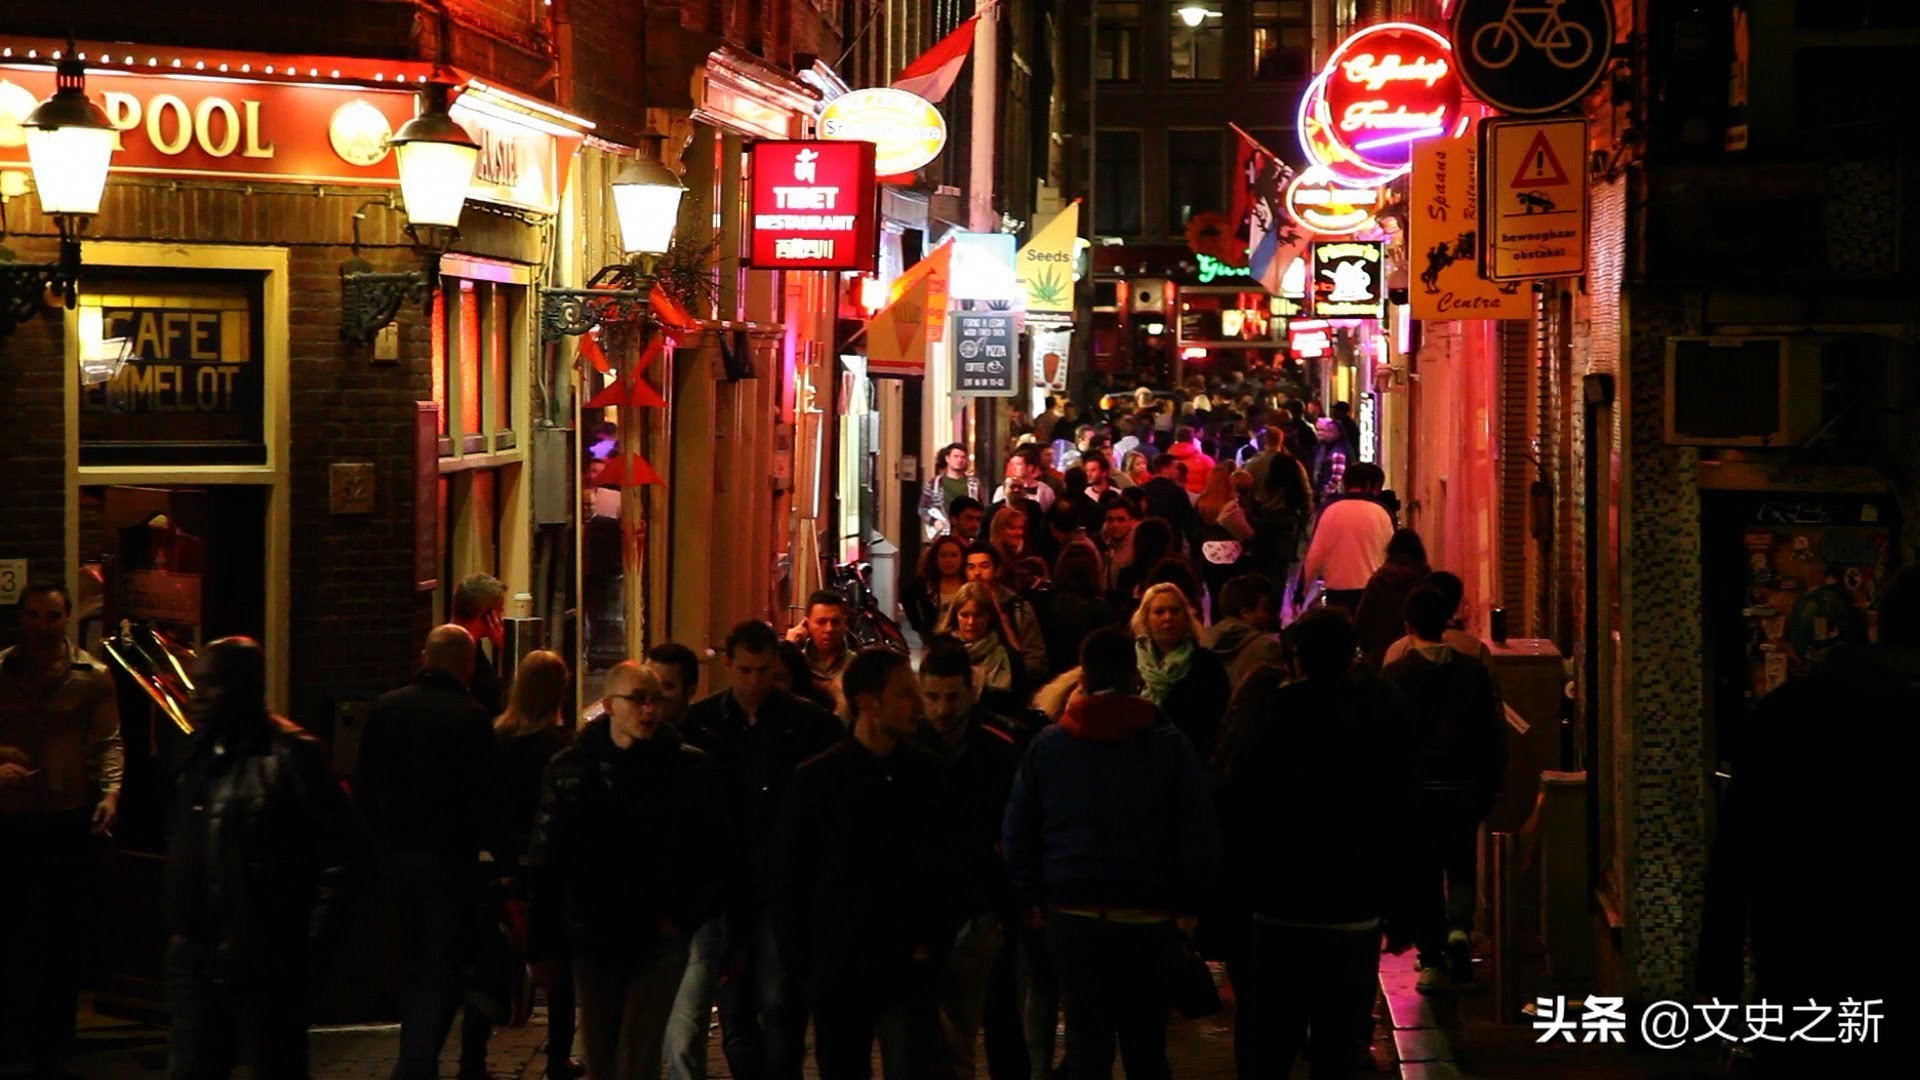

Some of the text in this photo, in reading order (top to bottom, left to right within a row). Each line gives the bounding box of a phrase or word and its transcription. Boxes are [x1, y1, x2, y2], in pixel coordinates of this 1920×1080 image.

[100, 91, 275, 158] POOL
[1427, 151, 1451, 223] Spaans
[1463, 148, 1476, 221] Restaurant
[772, 187, 840, 209] TIBET
[755, 215, 856, 231] RESTAURANT
[1027, 249, 1071, 263] Seeds
[1513, 248, 1566, 260] obstakel
[1437, 292, 1501, 312] Centra
[985, 345, 1006, 357] PIZZA
